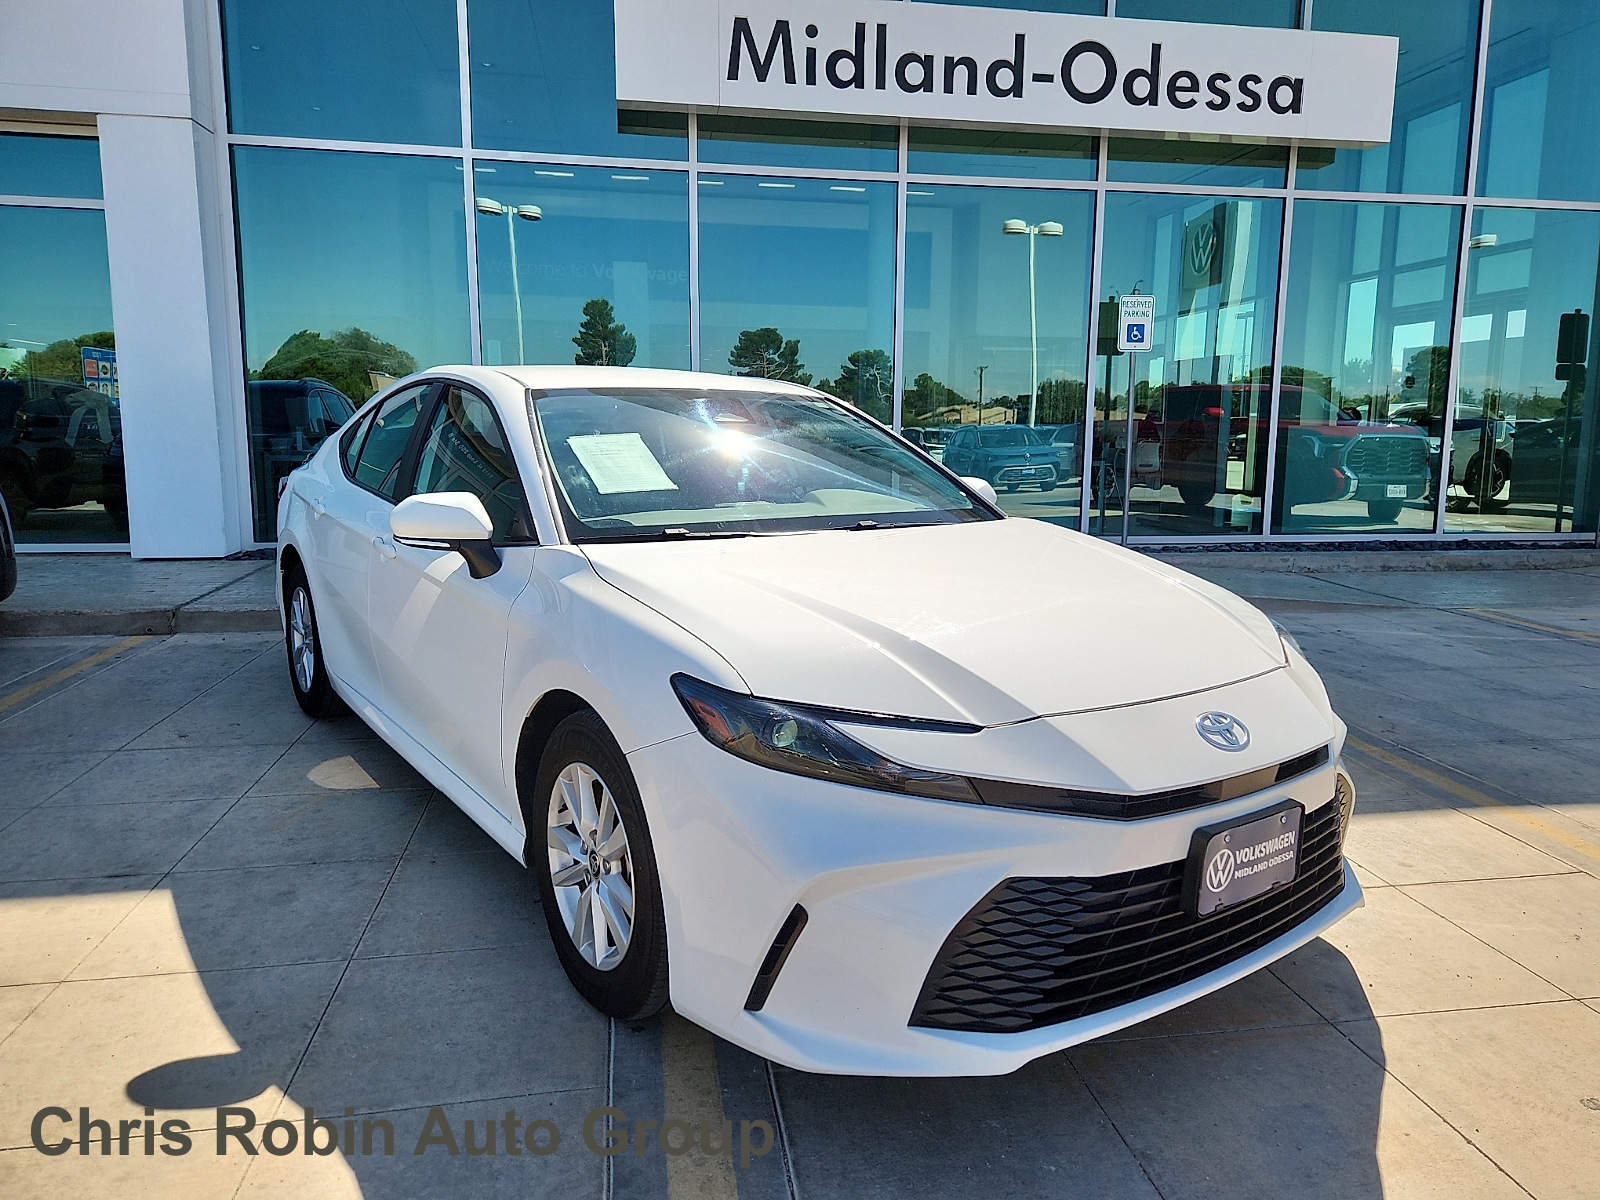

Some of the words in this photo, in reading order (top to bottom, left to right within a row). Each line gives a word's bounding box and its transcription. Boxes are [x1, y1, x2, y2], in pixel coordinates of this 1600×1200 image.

[727, 15, 1304, 114] Midland-Odessa
[484, 258, 565, 277] Wecome
[1123, 300, 1152, 308] RESERVED
[1124, 310, 1150, 318] PARKING
[1236, 831, 1296, 865] VOLKSWAGEN
[1234, 862, 1268, 879] MIDLAND
[1269, 851, 1294, 867] ODESSA
